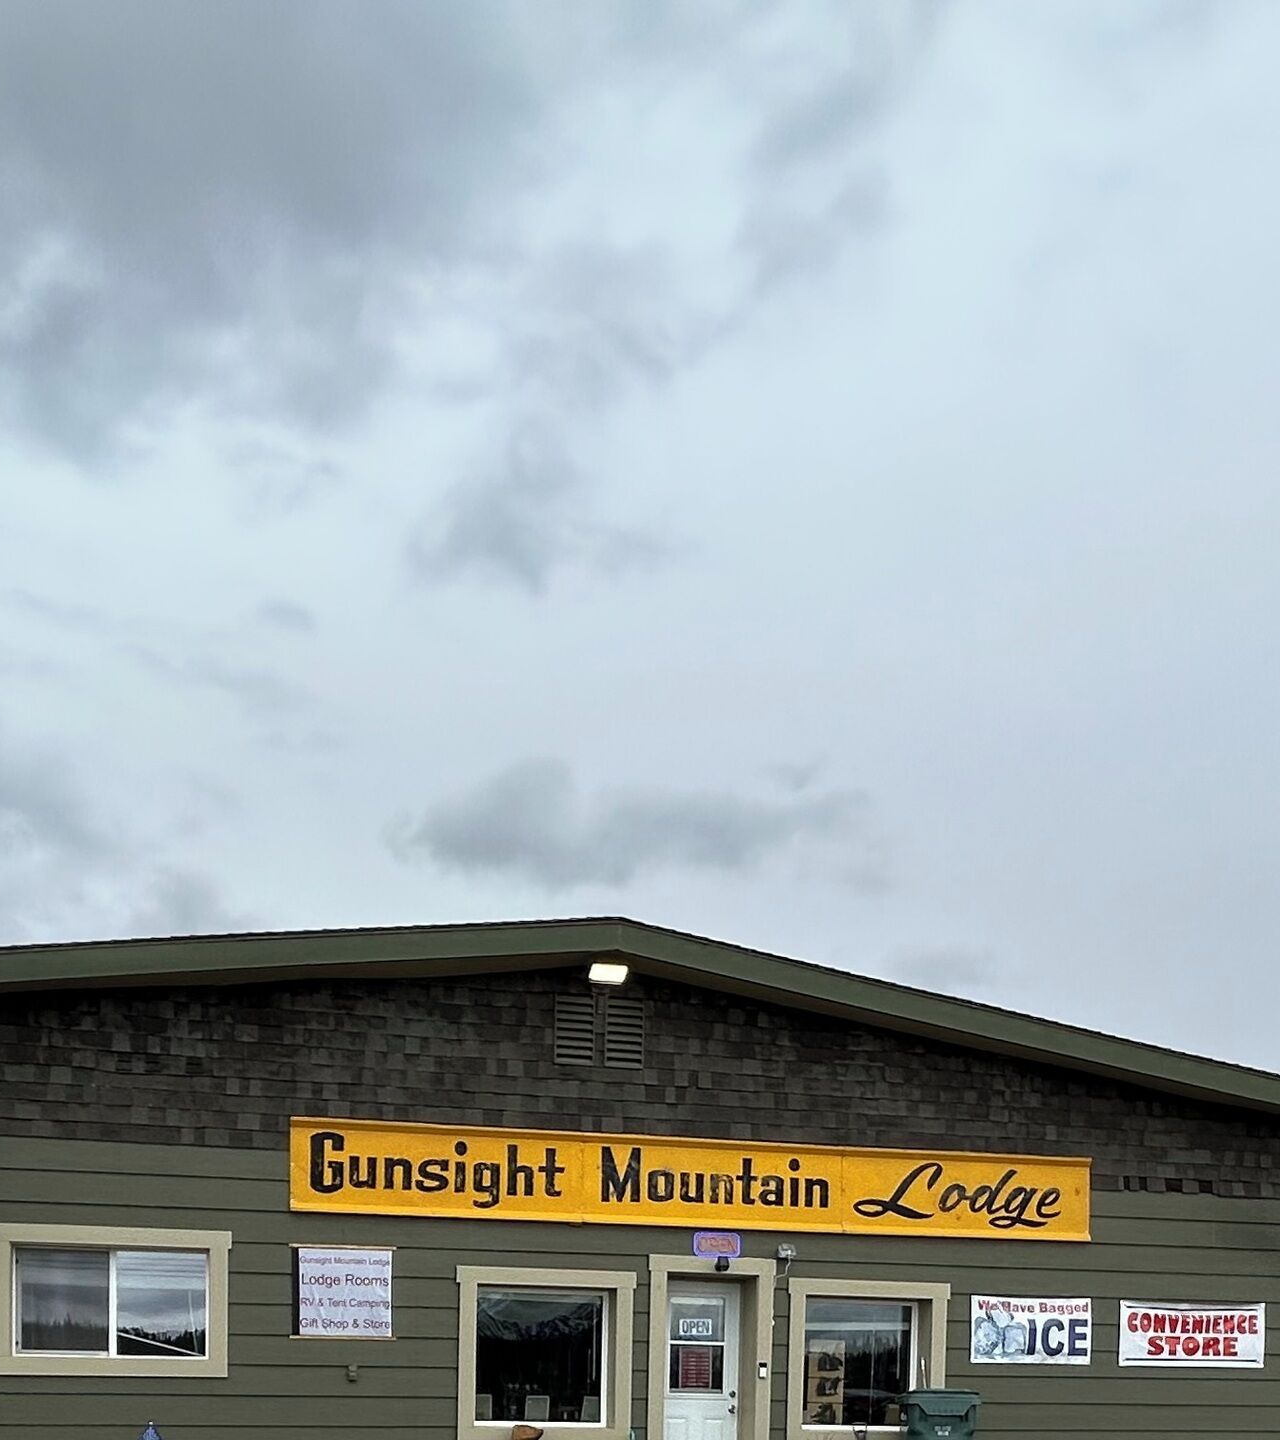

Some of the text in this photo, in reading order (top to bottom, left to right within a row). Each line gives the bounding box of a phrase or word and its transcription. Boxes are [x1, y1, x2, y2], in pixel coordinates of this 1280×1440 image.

[309, 1131, 1062, 1229] Gunsight Mountain Lodge
[300, 1256, 390, 1267] Gunsight Mountain Lodge
[301, 1273, 389, 1288] Lodge Rooms
[300, 1297, 390, 1310] RV & Tent Camping
[978, 1299, 1089, 1315] We Have Bagged
[300, 1317, 390, 1330] Gift Shop & Store
[681, 1320, 710, 1334] OPEN
[1127, 1312, 1258, 1334] CONVENIENCE
[1027, 1318, 1089, 1356] ICE
[1147, 1335, 1238, 1357] STORE
